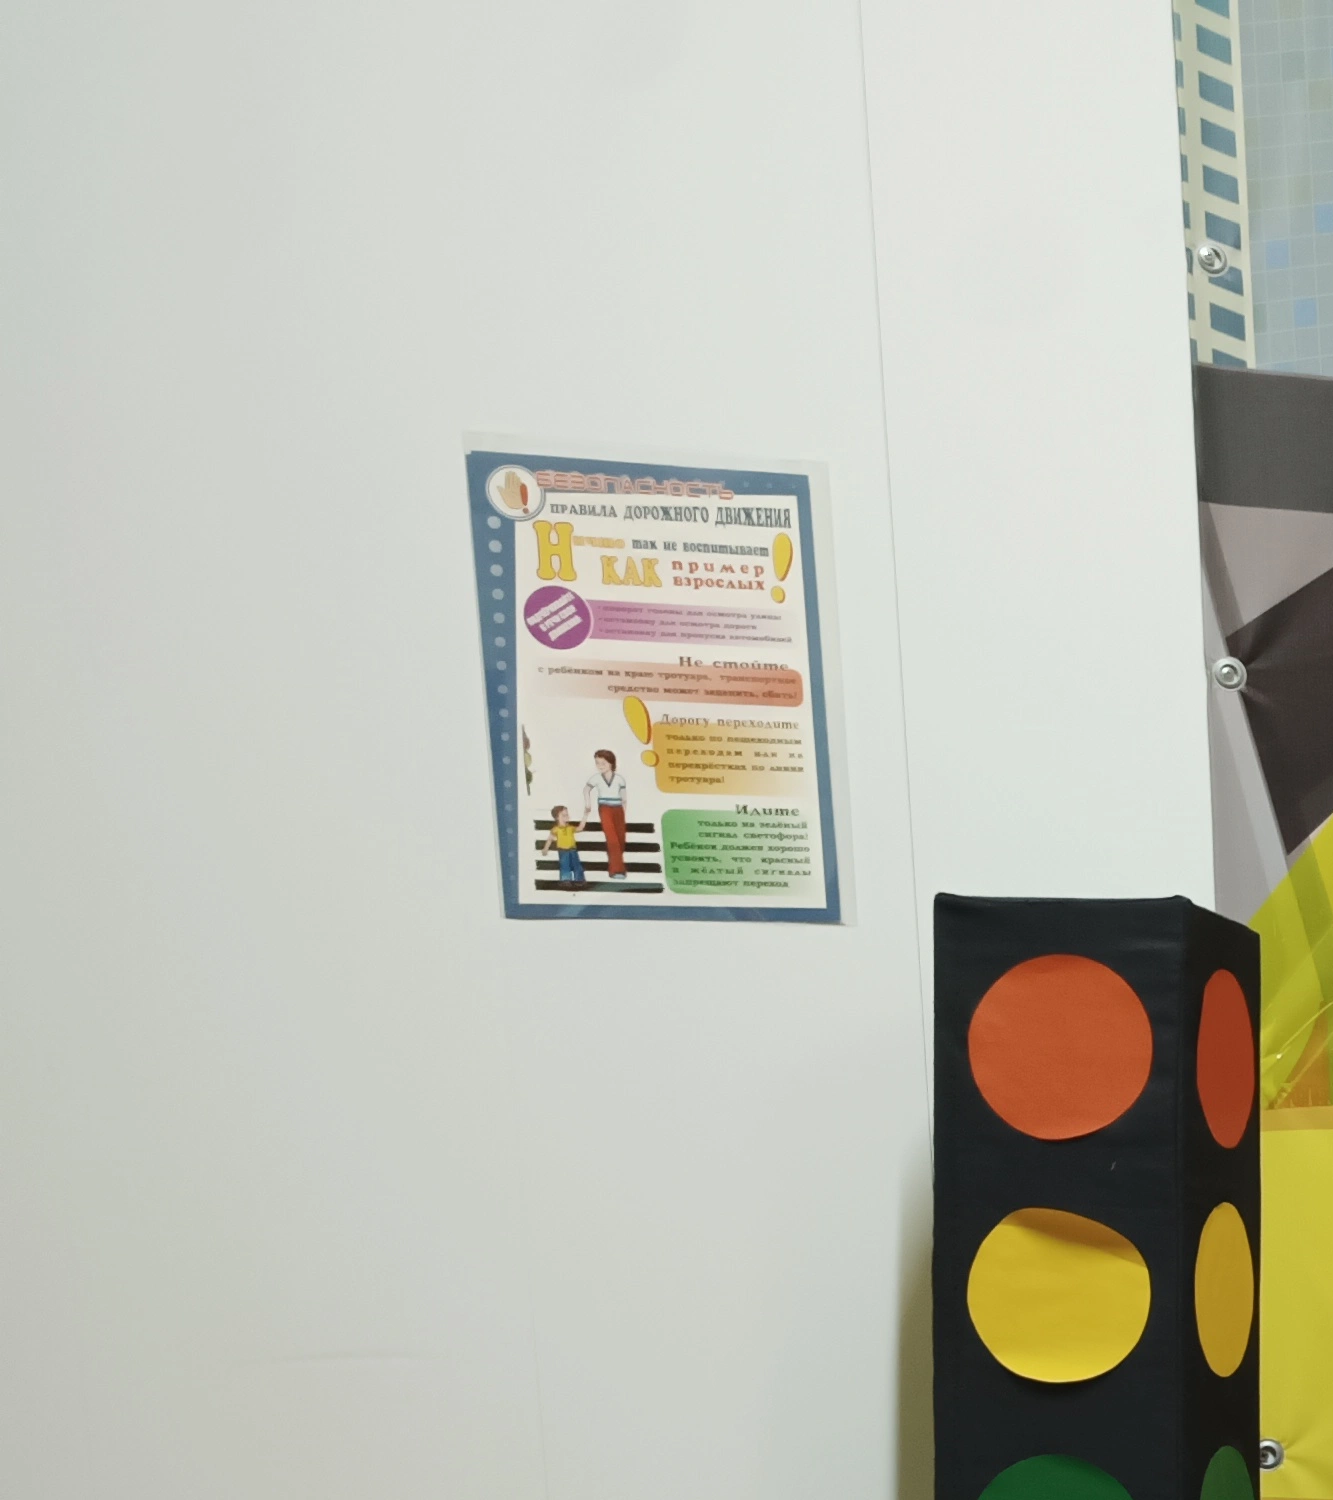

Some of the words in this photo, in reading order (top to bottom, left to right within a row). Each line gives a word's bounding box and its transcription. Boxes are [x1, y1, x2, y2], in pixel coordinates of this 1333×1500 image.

[550, 503, 618, 518] ПРАВИЛА
[623, 504, 709, 524] ДОРОЖНОГО
[715, 507, 791, 528] ДВИЖЕНИЯ
[632, 538, 658, 550] так
[683, 541, 769, 557] воспитывает
[601, 555, 662, 588] КАК
[672, 560, 764, 576] пример
[673, 576, 764, 590] взрослых
[678, 656, 703, 668] Не
[712, 657, 789, 671] стойте
[660, 713, 710, 728] Дорогу
[717, 718, 799, 730] переходите
[735, 803, 800, 817] Идите
